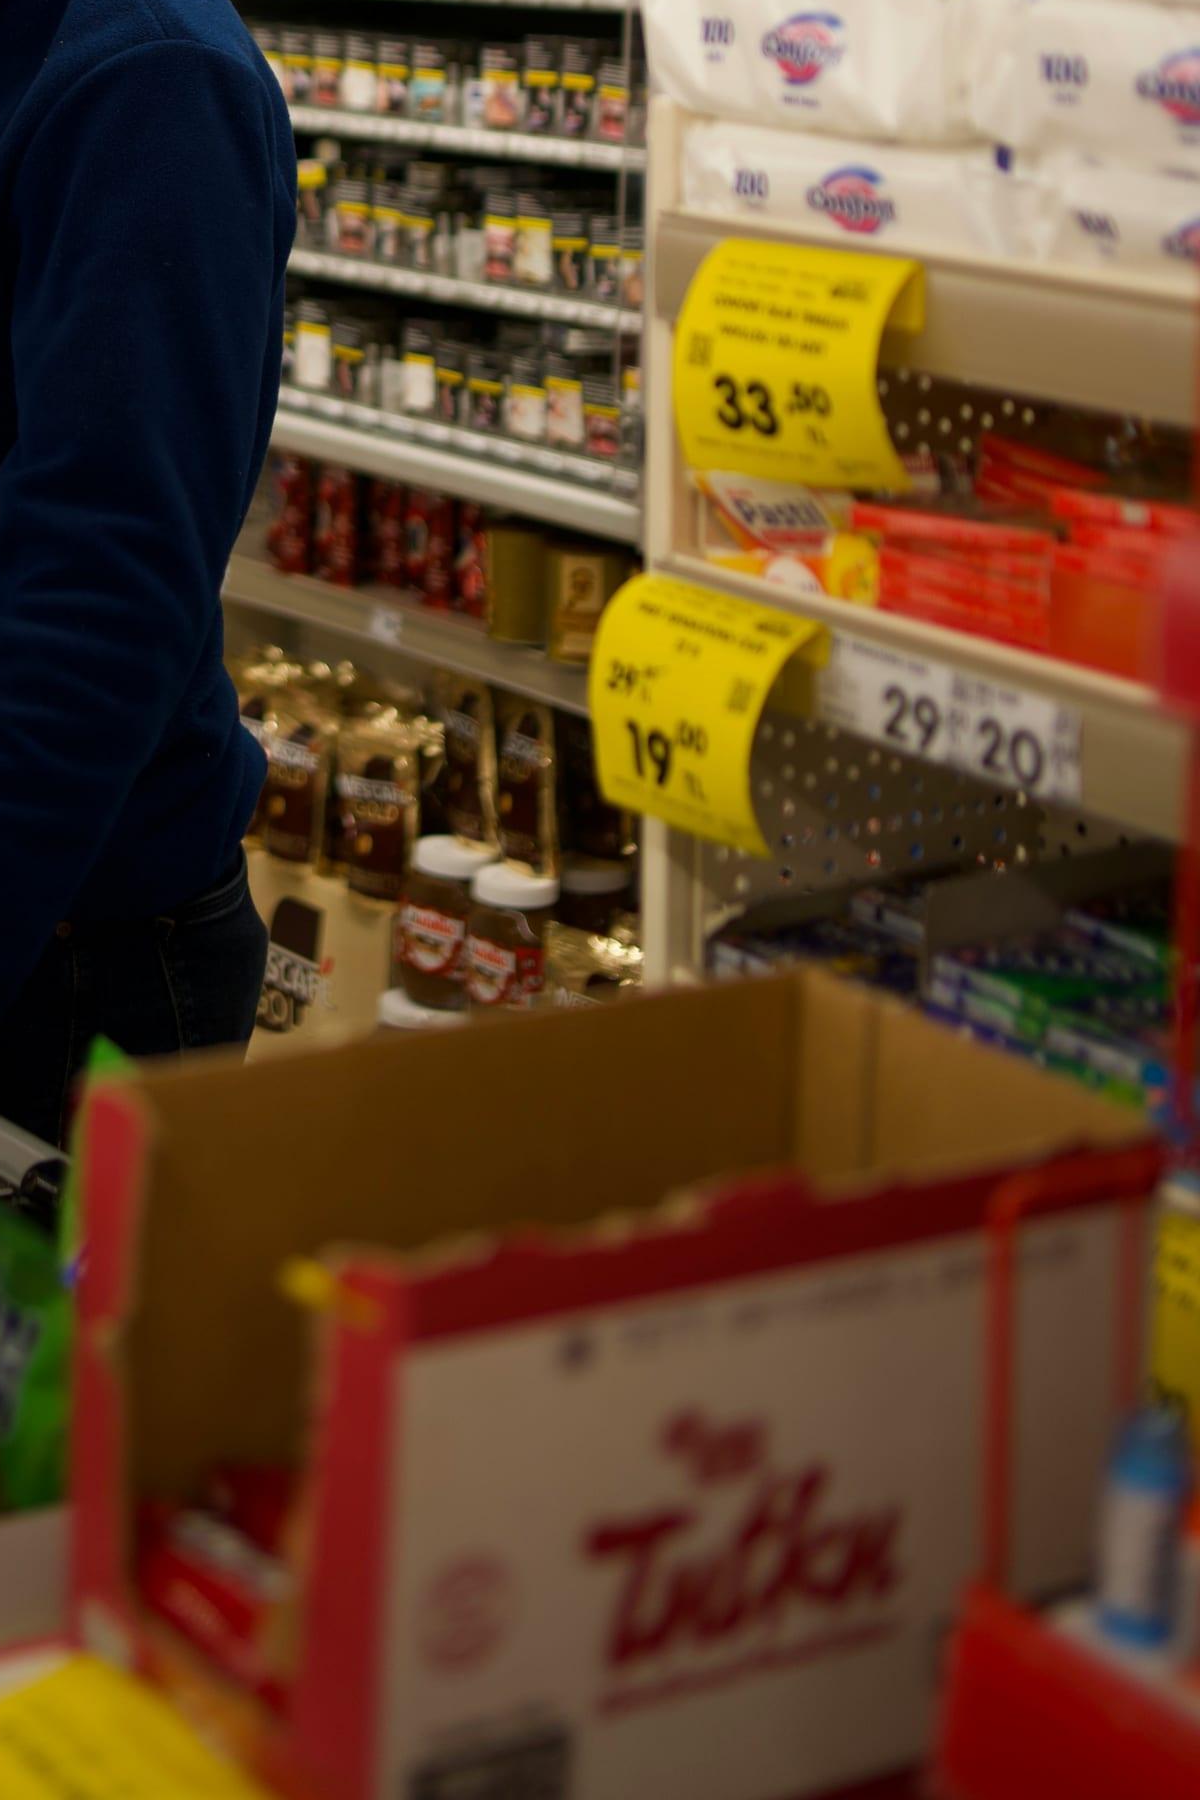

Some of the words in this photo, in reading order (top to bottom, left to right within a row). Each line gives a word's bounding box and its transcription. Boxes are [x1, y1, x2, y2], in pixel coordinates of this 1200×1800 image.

[714, 373, 779, 437] 33
[882, 682, 941, 751] 29
[624, 718, 671, 786] 19
[978, 714, 1044, 788] 20
